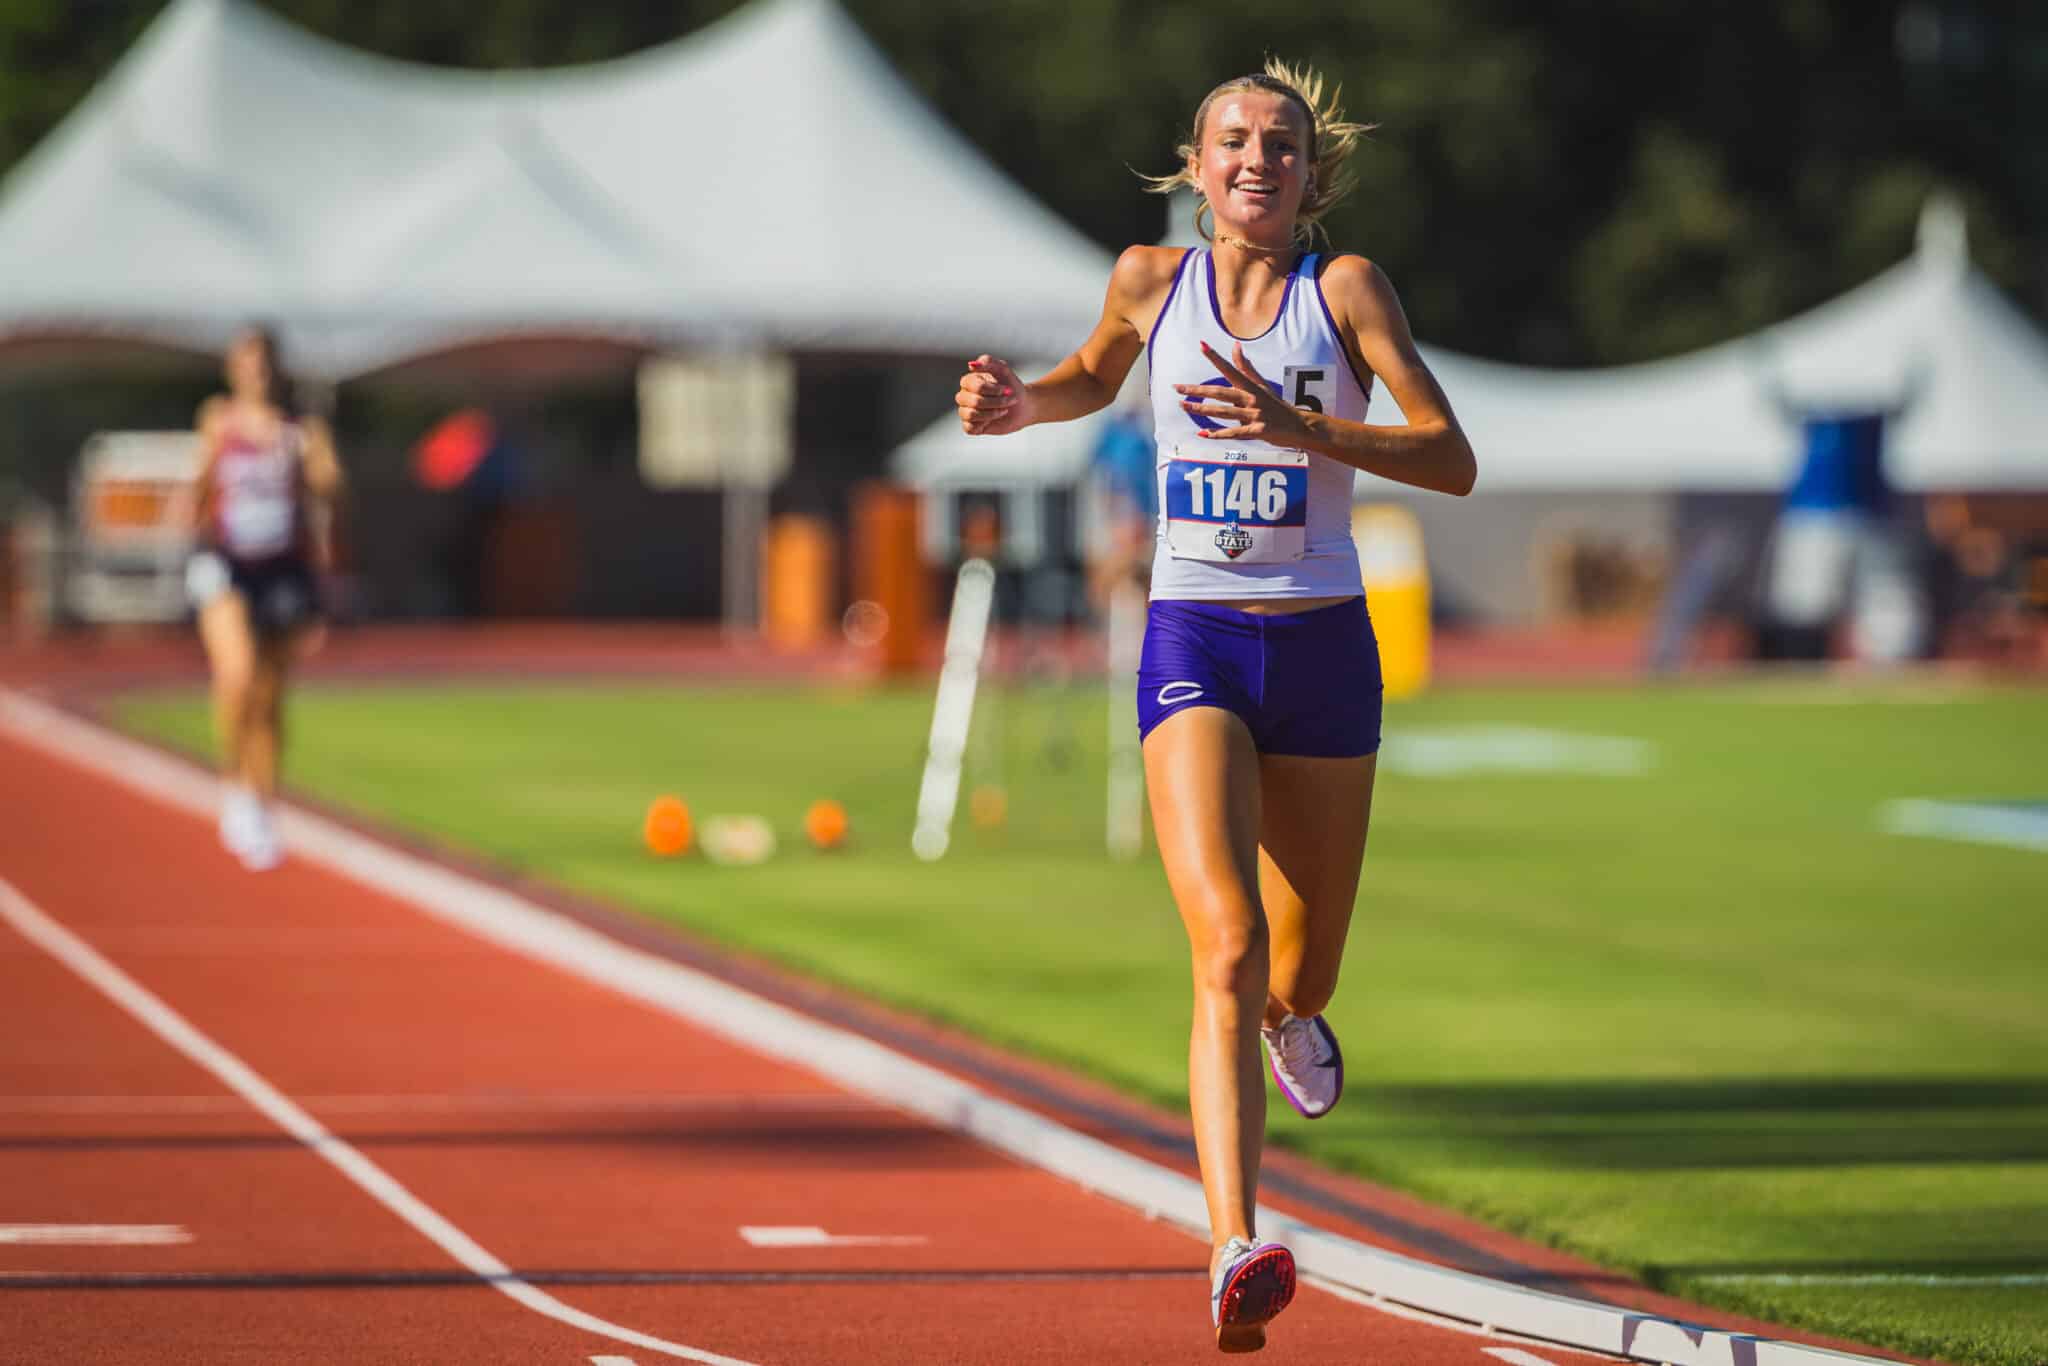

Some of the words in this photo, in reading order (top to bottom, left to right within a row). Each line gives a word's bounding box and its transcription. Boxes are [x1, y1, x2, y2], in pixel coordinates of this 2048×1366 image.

[1294, 370, 1323, 415] 5
[1224, 451, 1248, 461] 2026
[1184, 467, 1287, 521] 1146
[1215, 535, 1252, 548] STATE
